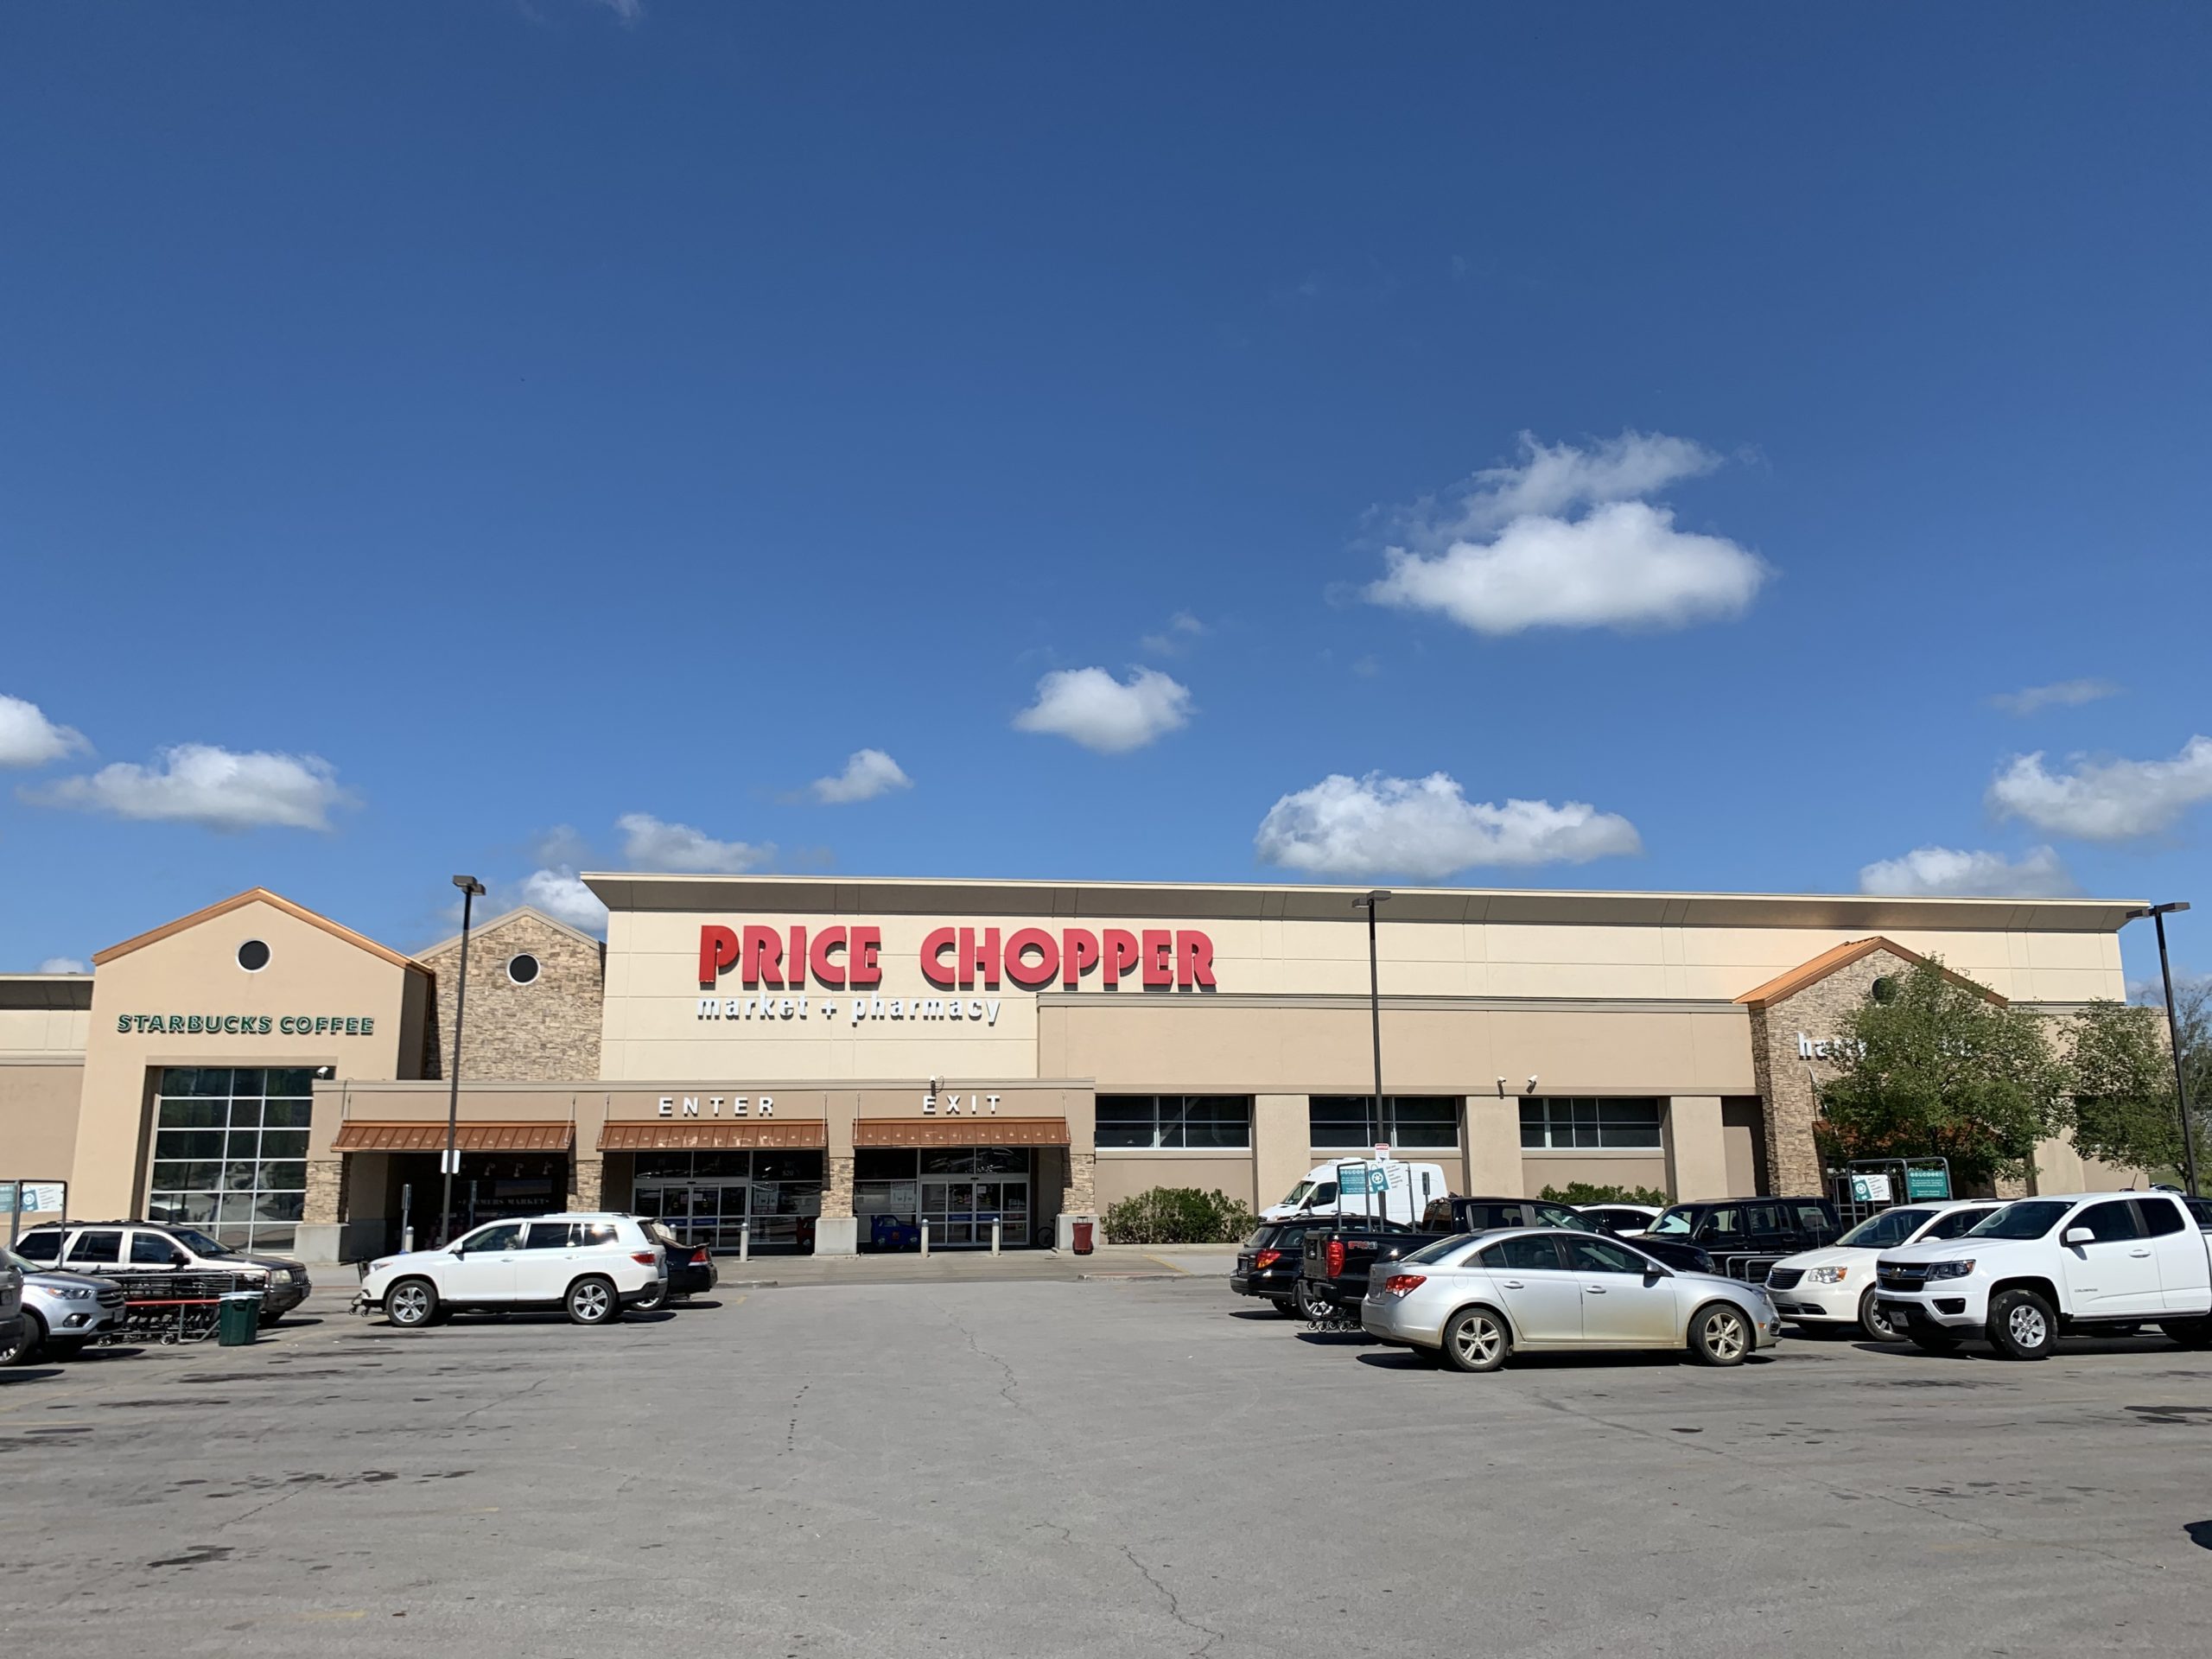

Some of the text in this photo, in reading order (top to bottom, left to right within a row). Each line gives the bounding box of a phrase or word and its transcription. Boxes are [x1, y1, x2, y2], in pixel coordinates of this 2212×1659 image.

[698, 925, 1217, 986] PRICE CHOPPER
[697, 992, 808, 1018] market
[852, 992, 1001, 1027] pharmacy
[117, 1014, 374, 1034] STARBUCKS COFFEE
[658, 1097, 774, 1116] ENTER
[922, 1095, 1001, 1114] EXIT
